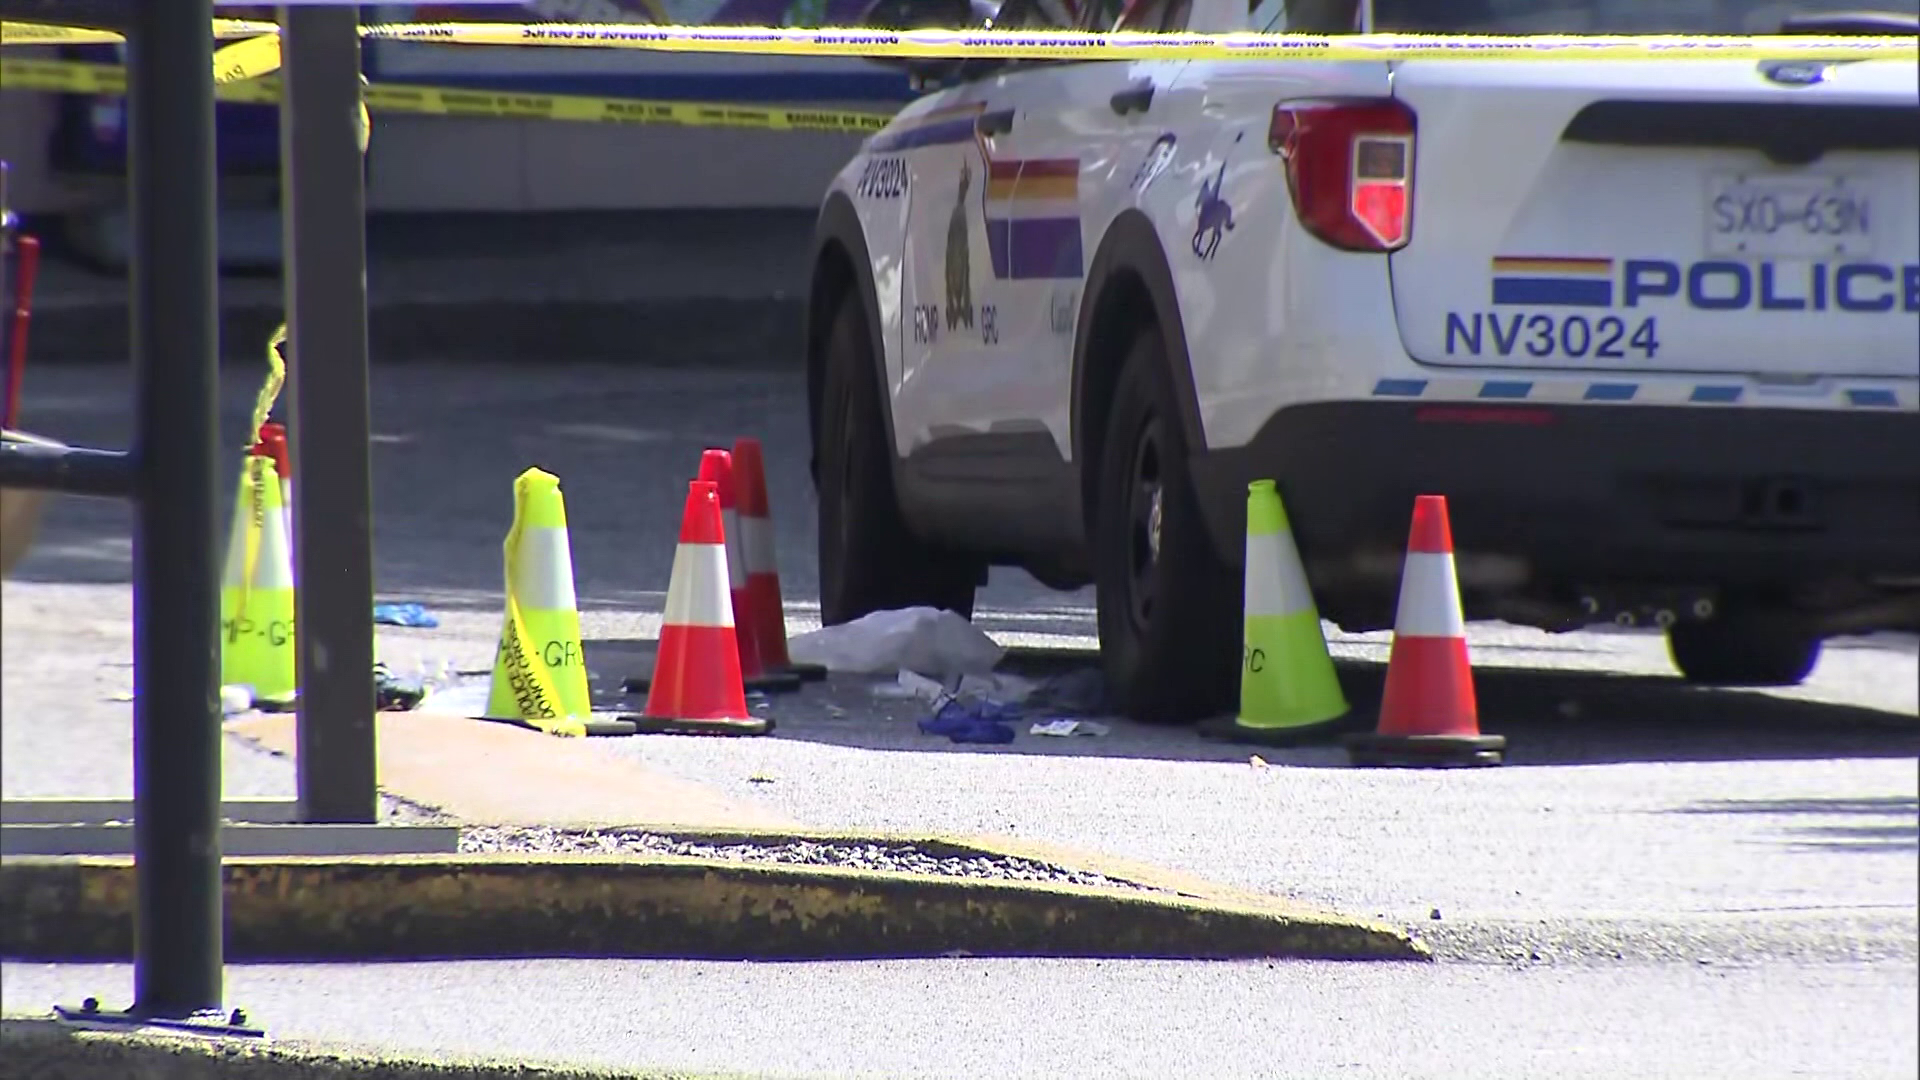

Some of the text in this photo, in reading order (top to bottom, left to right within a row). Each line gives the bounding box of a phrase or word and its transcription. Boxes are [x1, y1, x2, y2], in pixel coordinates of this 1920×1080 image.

[857, 157, 909, 200] NV3024
[914, 305, 999, 345] RCMP GRC
[1446, 312, 1660, 358] NV3024
